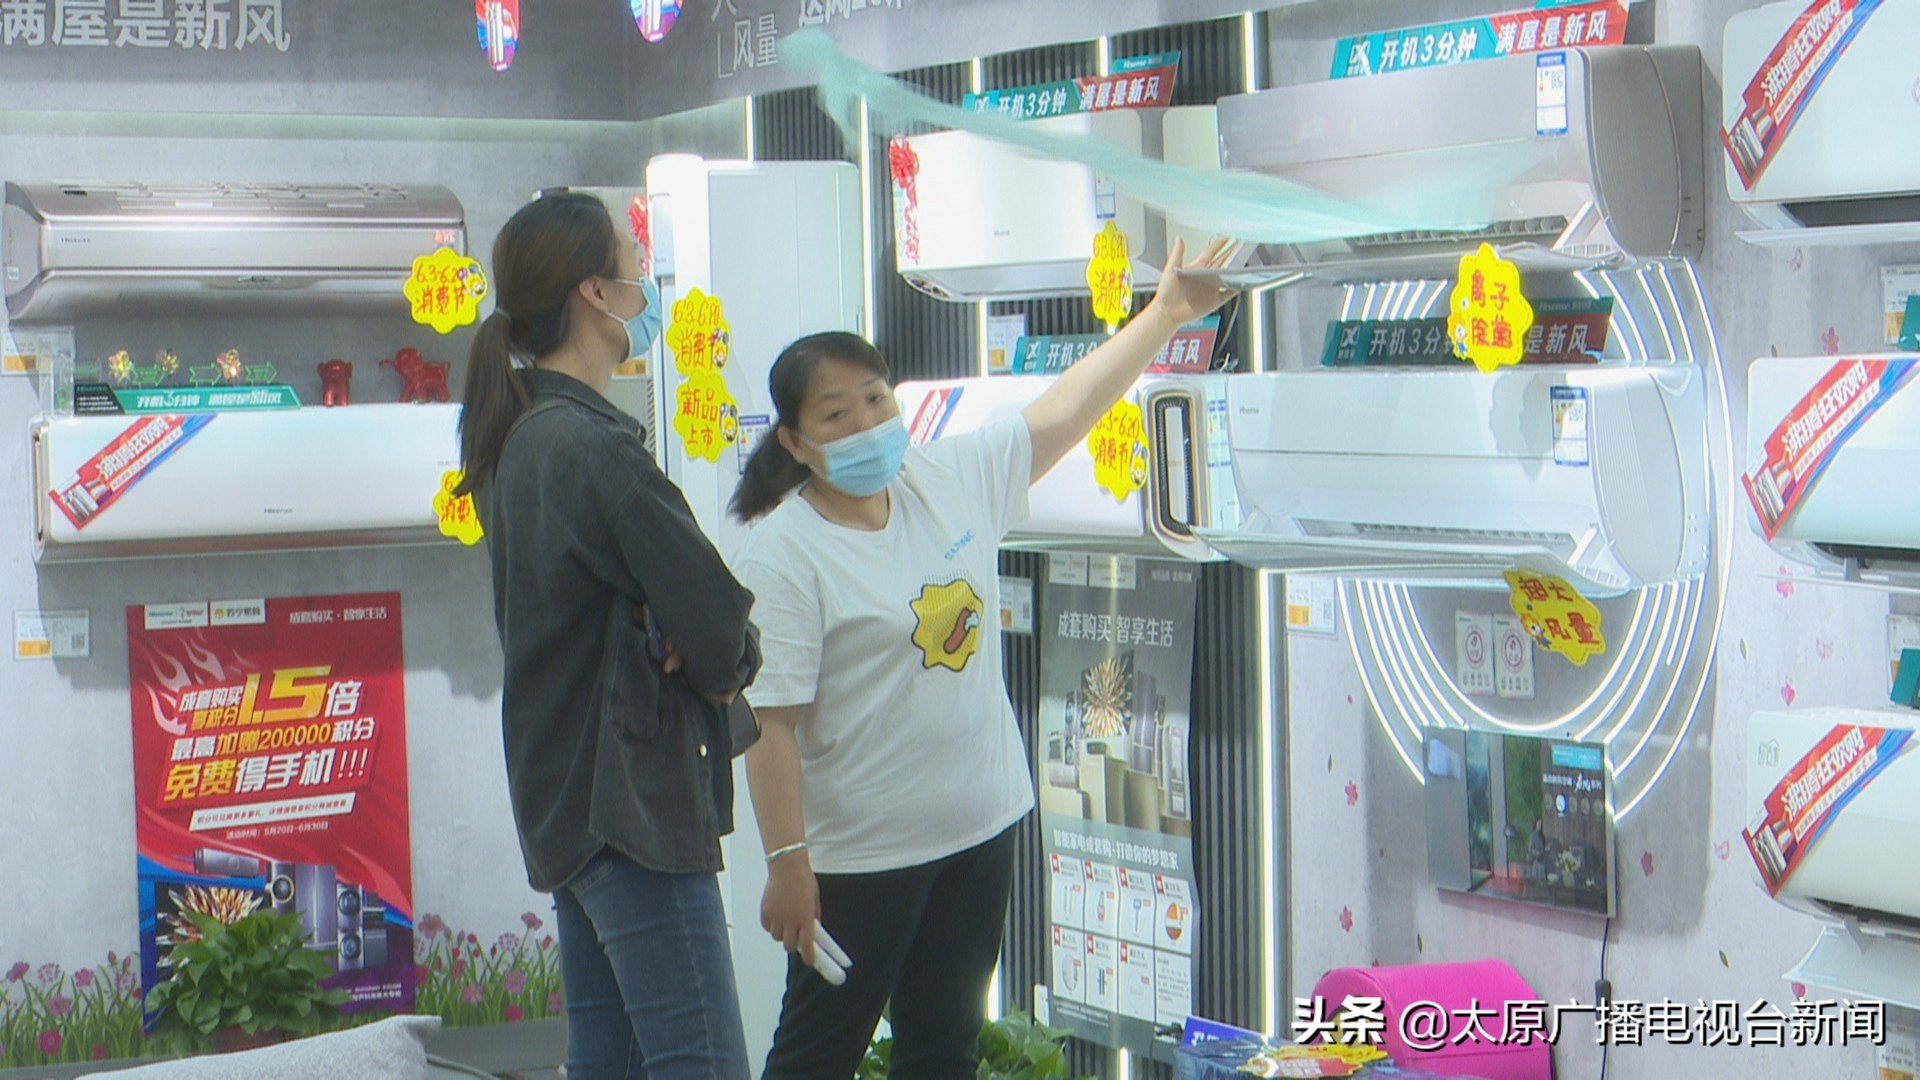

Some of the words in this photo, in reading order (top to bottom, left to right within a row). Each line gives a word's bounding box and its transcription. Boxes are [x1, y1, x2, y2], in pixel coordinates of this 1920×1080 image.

[0, 0, 290, 51] 满屋是新风
[1379, 28, 1478, 70] 开机3分钟
[1495, 10, 1607, 54] 满屋是新风
[998, 88, 1067, 118] 开机3分钟
[1079, 76, 1160, 111] 满屋是新风
[1369, 327, 1453, 356] 开机3分
[681, 386, 719, 422] 新品
[686, 424, 714, 447] 上市
[1057, 610, 1112, 644] 成套购买
[1115, 614, 1175, 649] 智享生活
[170, 716, 376, 761] 最高加赠200000积分
